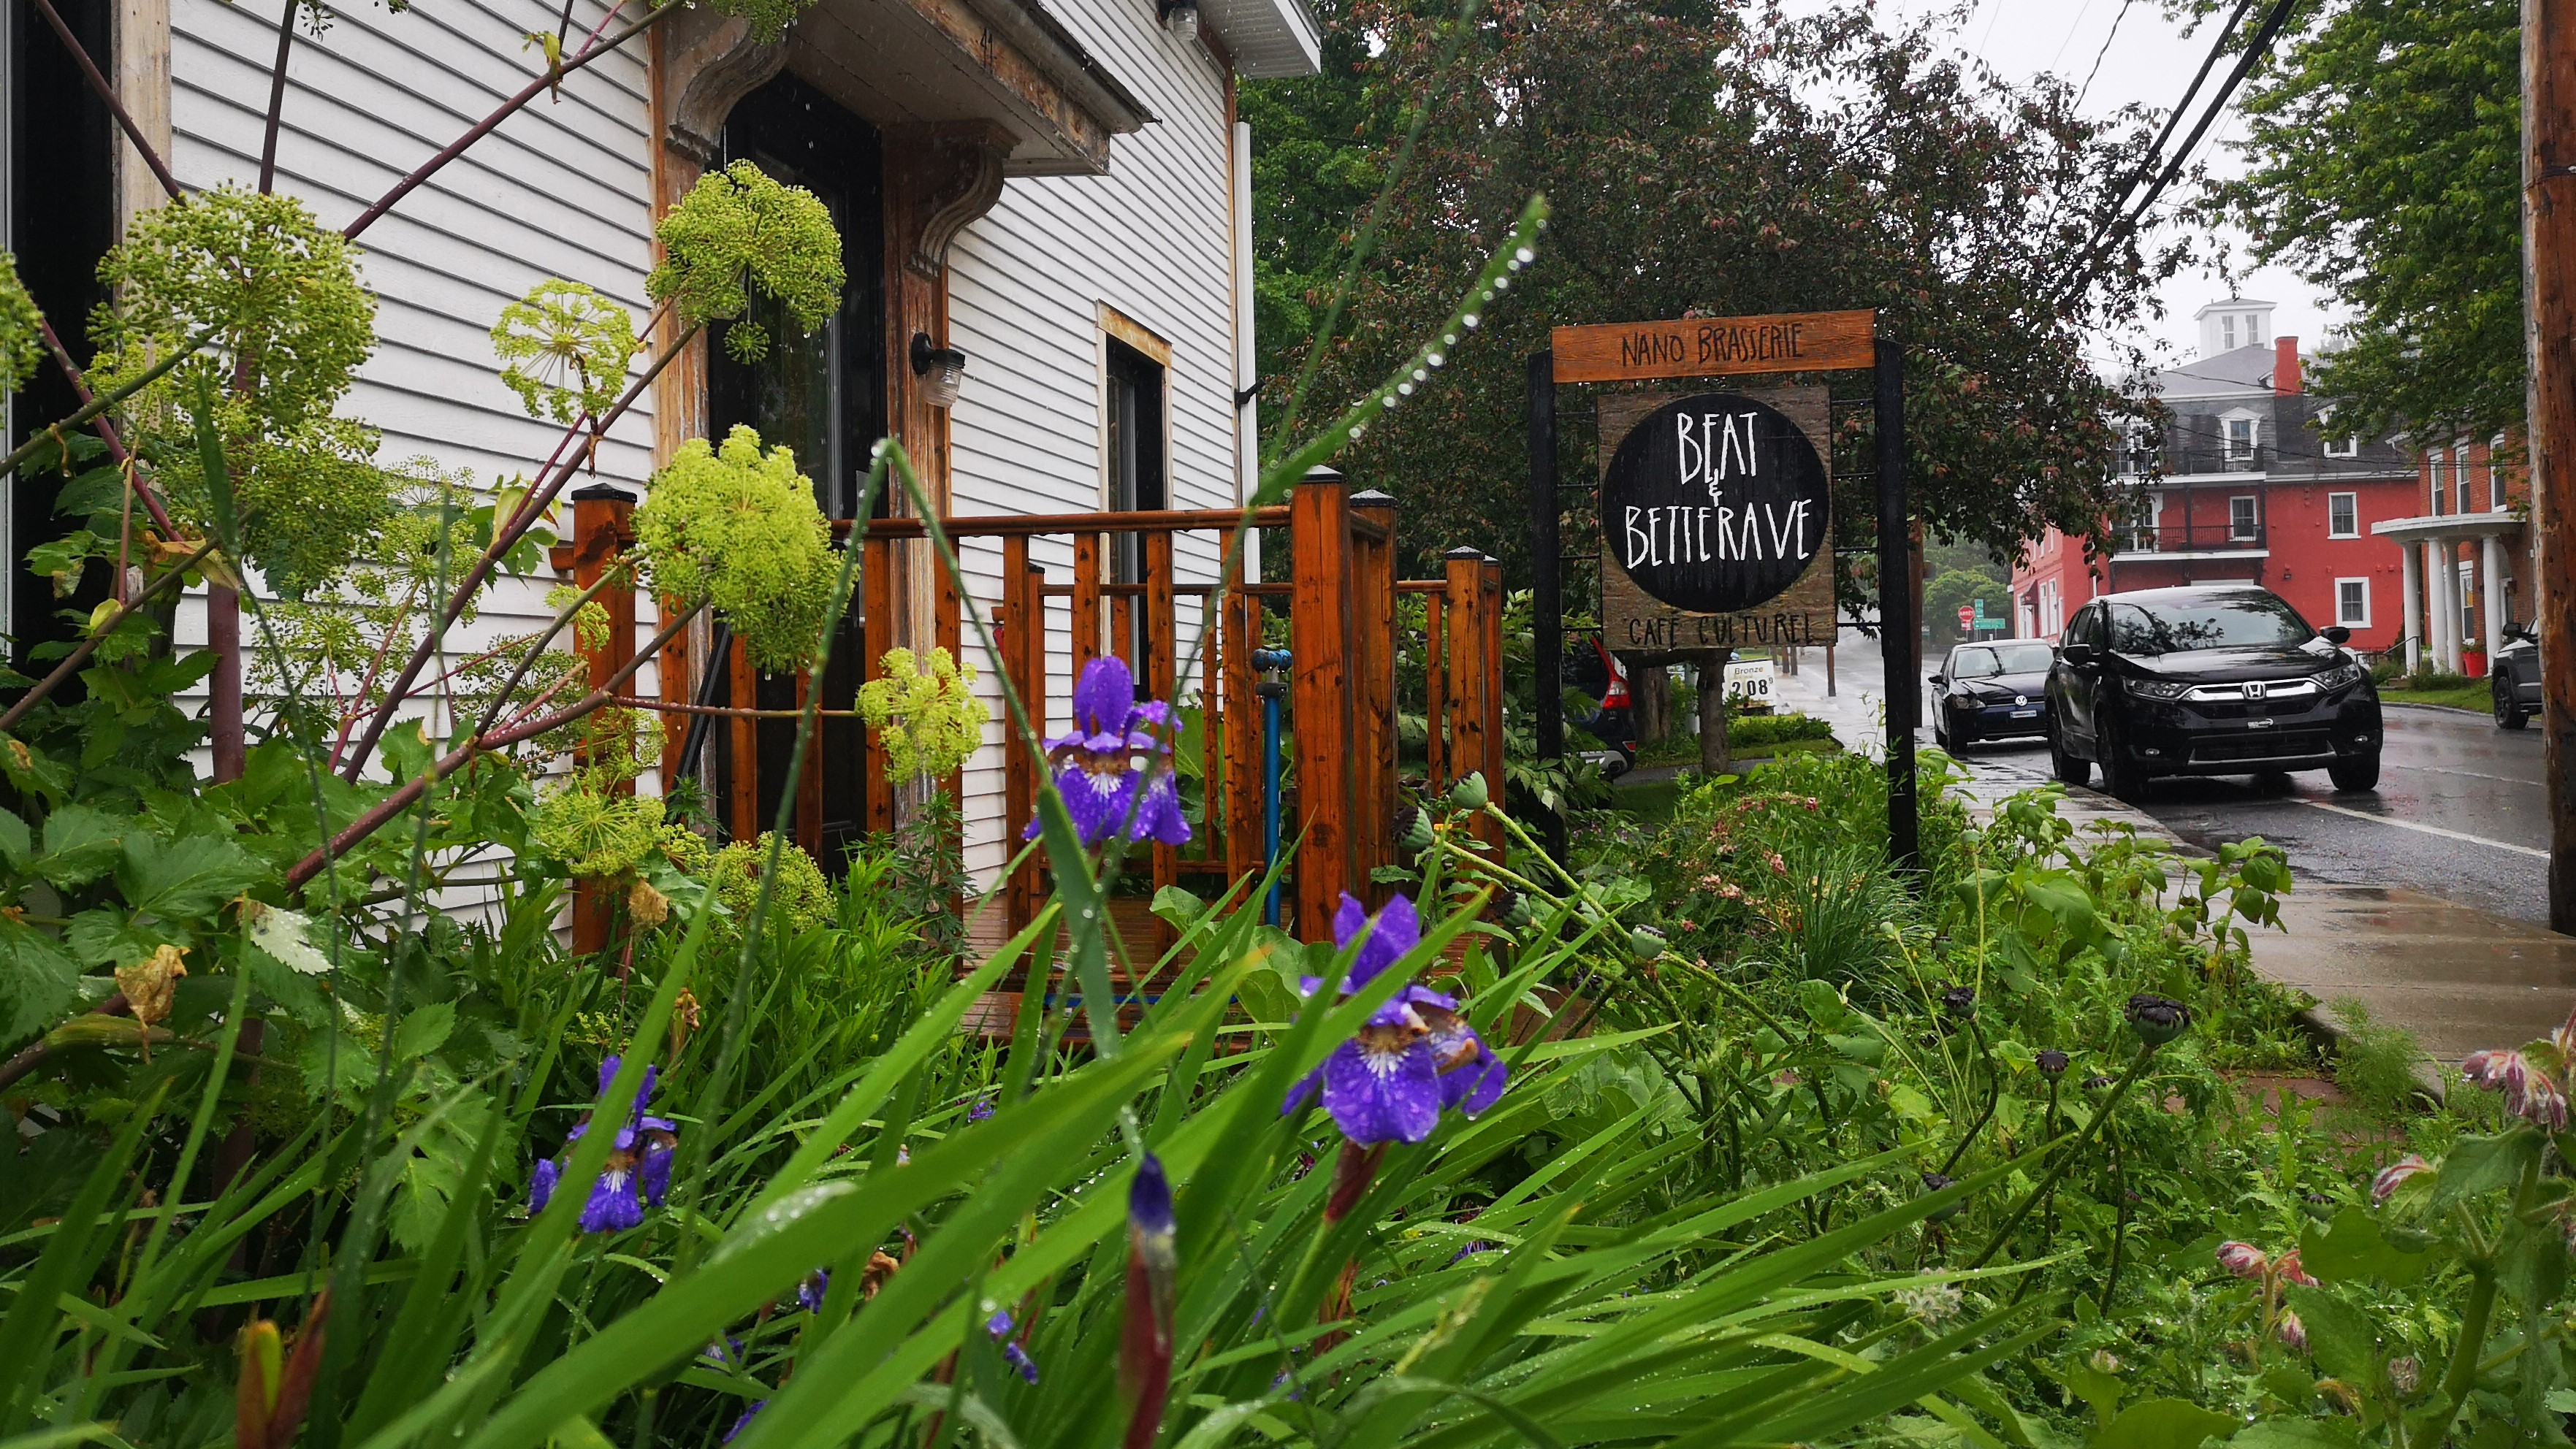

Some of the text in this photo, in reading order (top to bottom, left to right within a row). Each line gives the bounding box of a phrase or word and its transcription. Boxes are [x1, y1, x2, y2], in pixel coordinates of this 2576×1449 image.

[1622, 322, 1804, 367] NANO BRASSERIE
[1677, 412, 1758, 484] BEAT
[1709, 468, 1723, 507] &
[1626, 500, 1812, 569] BETTERAVE
[1699, 613, 1813, 645] CULTUREL
